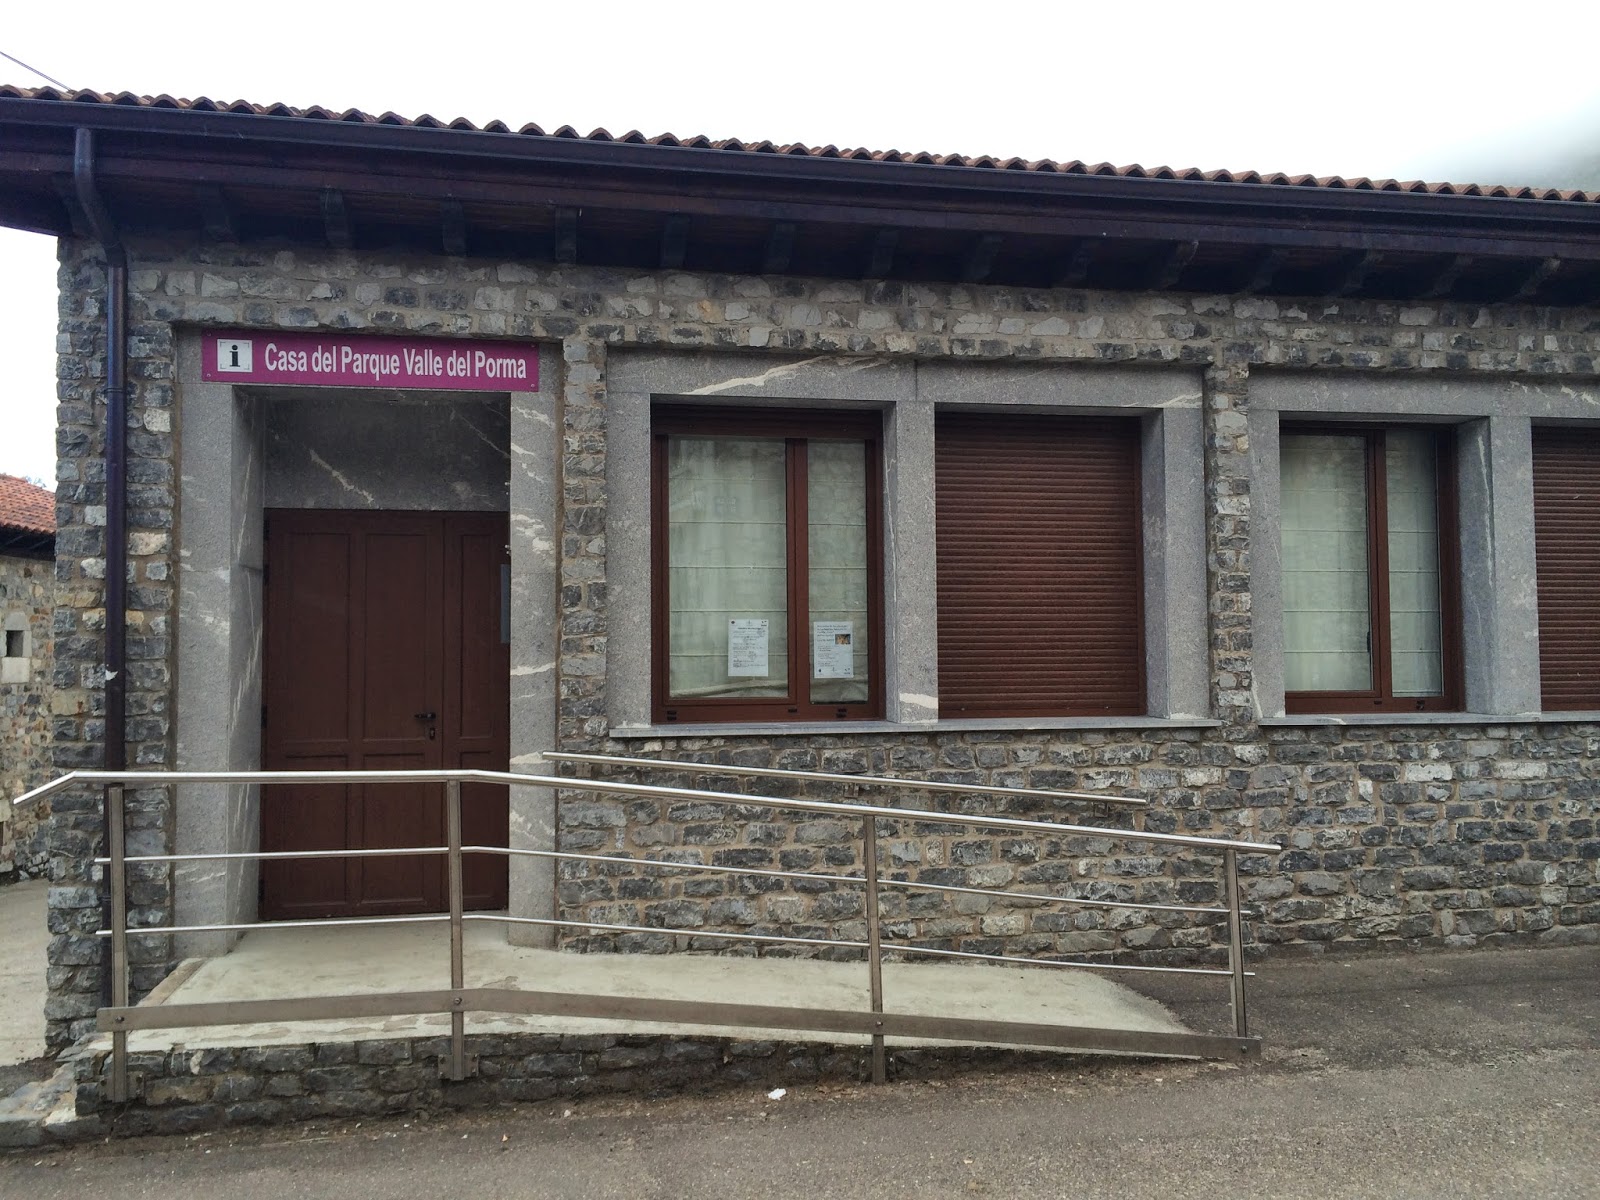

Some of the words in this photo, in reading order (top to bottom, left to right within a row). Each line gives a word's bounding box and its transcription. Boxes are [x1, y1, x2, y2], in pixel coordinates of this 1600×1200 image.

[264, 343, 307, 371] Casa
[311, 345, 337, 373] del
[341, 346, 400, 381] Parque
[403, 348, 442, 377] Valle
[446, 350, 471, 378] del
[475, 351, 527, 379] Porma
